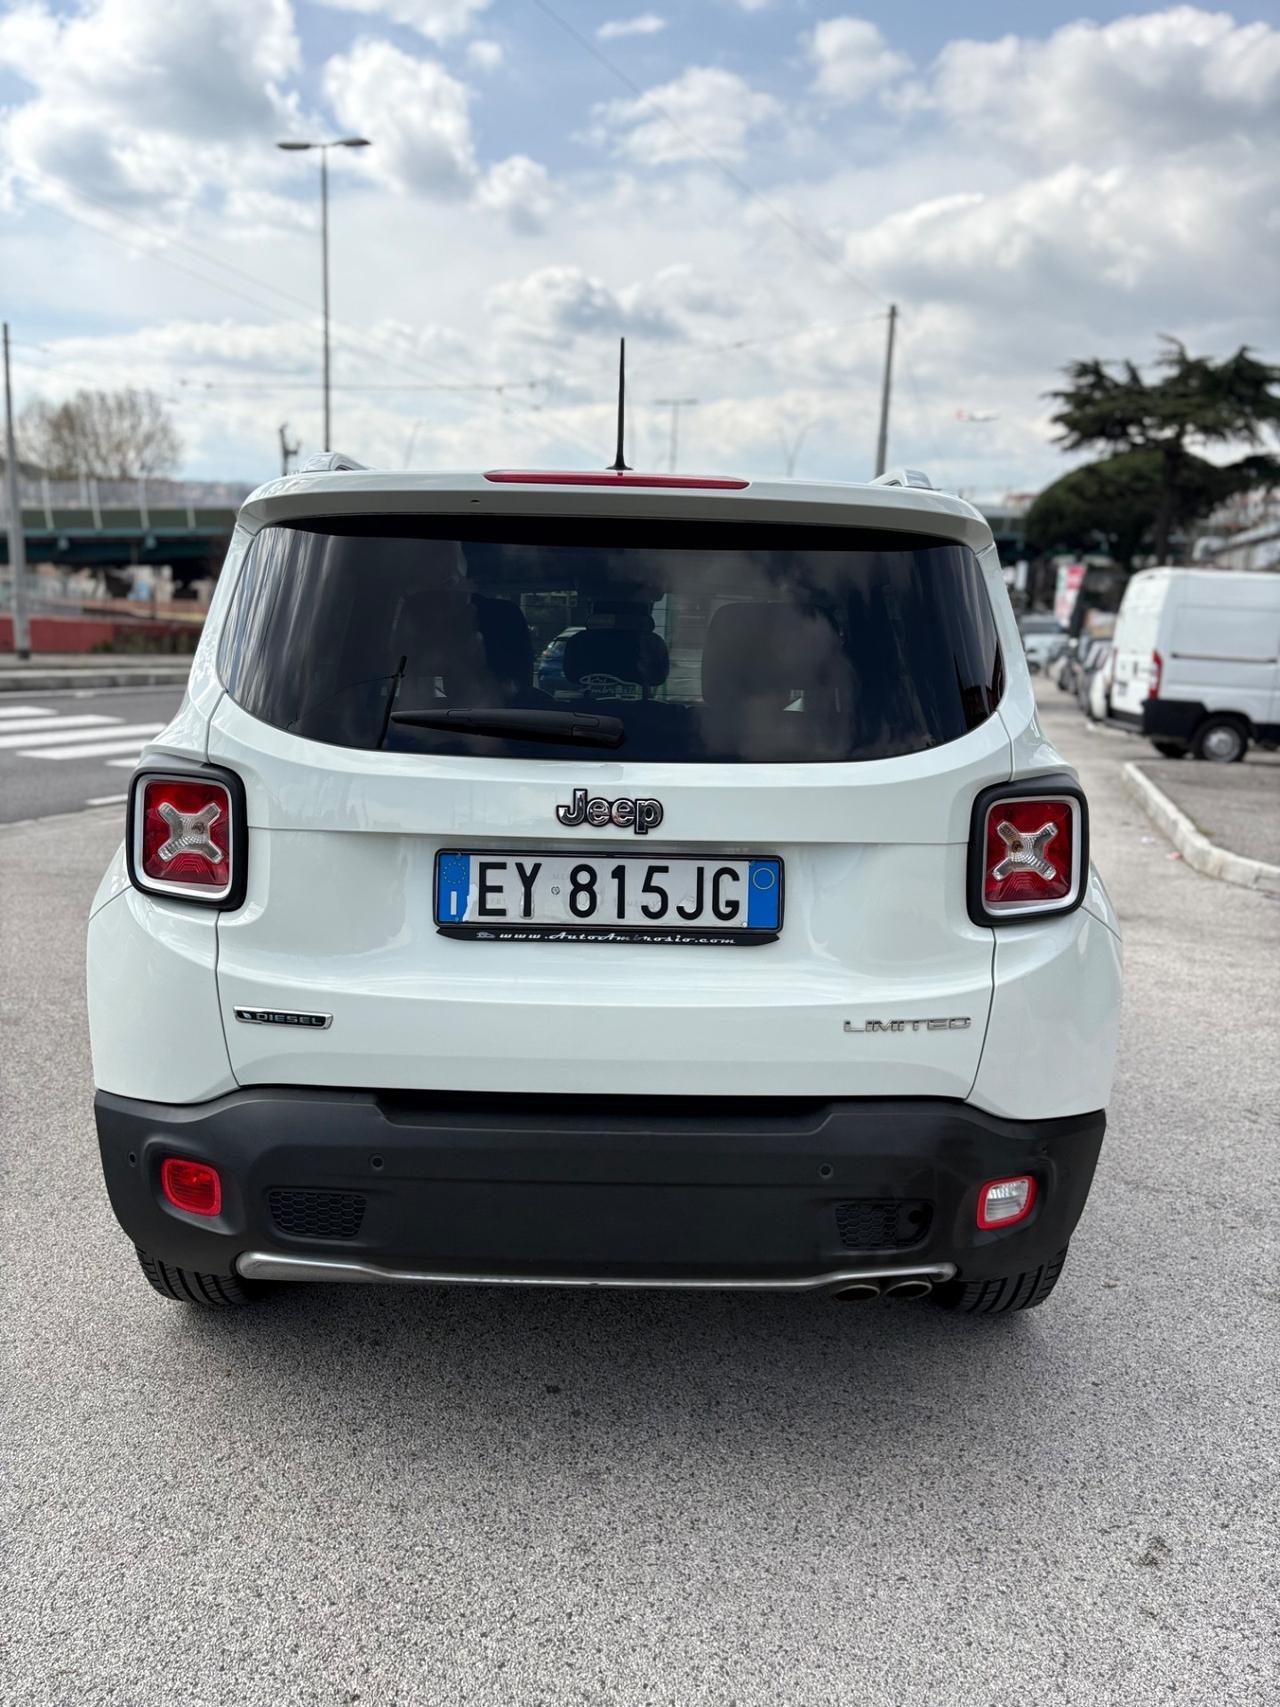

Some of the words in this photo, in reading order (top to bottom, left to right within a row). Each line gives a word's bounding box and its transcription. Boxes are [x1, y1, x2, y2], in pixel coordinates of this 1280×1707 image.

[556, 788, 664, 835] Jeep
[477, 861, 542, 918] EY
[568, 863, 741, 921] 815JG
[255, 1012, 323, 1025] DIESEL
[843, 1017, 971, 1032] LIMITED
